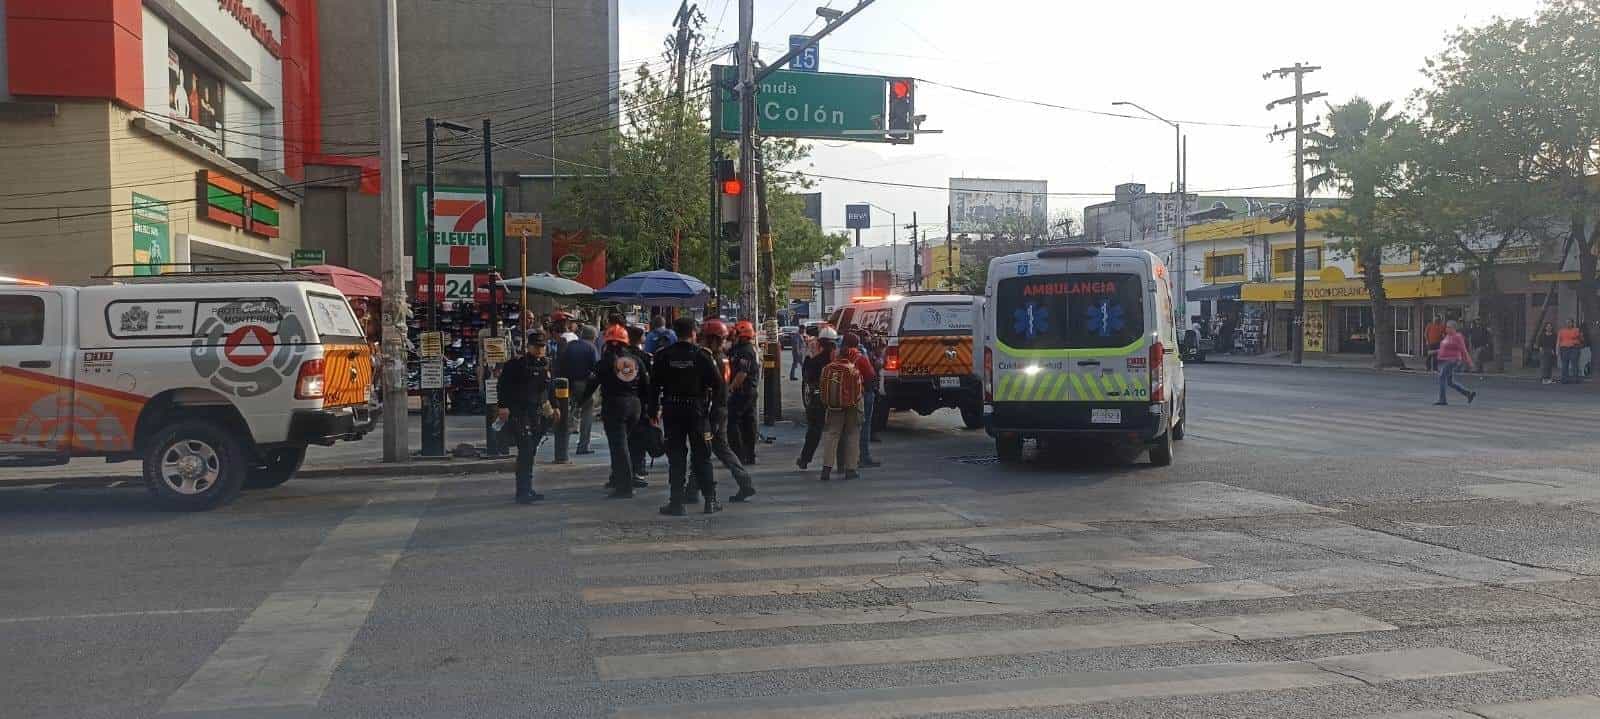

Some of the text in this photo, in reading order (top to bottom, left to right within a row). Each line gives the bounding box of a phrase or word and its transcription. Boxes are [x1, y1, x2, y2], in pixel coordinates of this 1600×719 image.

[793, 47, 815, 69] 15
[764, 101, 845, 126] Colón
[433, 197, 488, 268] 7
[446, 279, 474, 299] 24
[1023, 281, 1117, 297] AMBULANCIA
